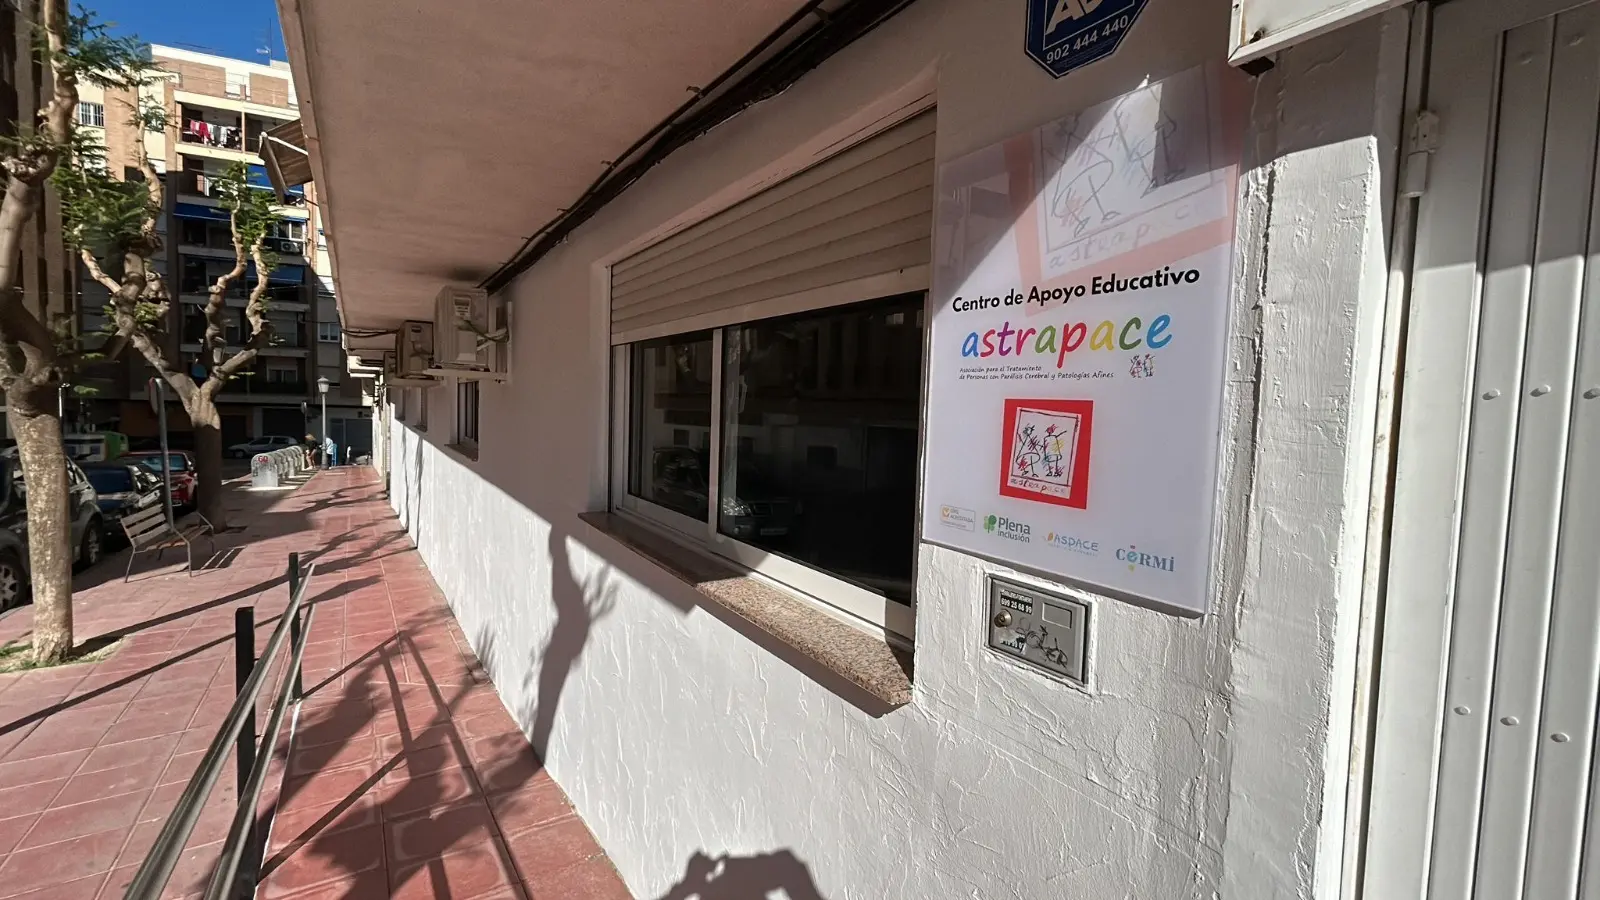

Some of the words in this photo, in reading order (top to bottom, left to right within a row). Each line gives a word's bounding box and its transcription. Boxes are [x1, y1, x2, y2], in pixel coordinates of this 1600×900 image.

[1046, 44, 1070, 64] 902
[1073, 30, 1098, 50] 444
[1102, 15, 1129, 36] 440
[952, 297, 1000, 312] Centro
[1004, 289, 1024, 305] de
[1027, 286, 1086, 306] Apoyo
[1091, 266, 1200, 295] Educativo
[961, 313, 1173, 369] astrapace
[1000, 372, 1023, 380] Parálisis
[1024, 371, 1050, 379] Cerebral
[1058, 371, 1090, 380] Patologías
[1092, 370, 1114, 378] Afines
[998, 516, 1031, 535] Plena
[997, 529, 1030, 543] inclusión
[1054, 533, 1099, 552] ASPACE
